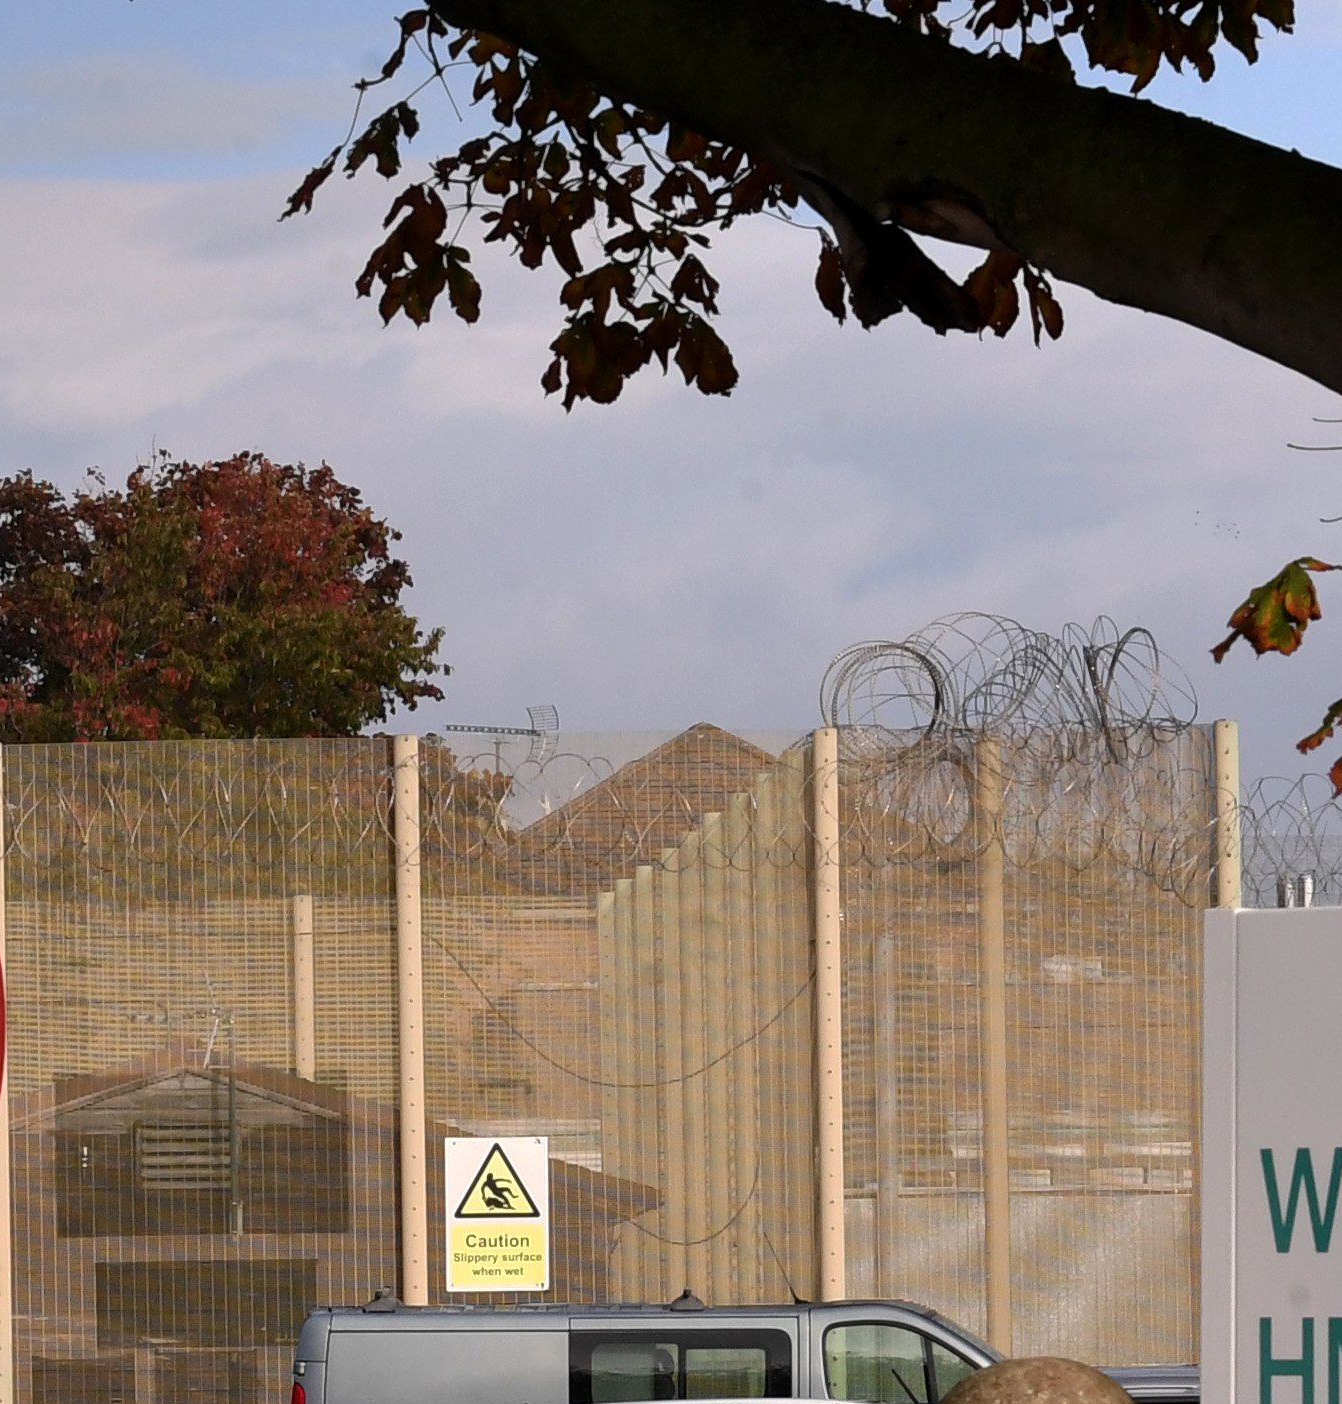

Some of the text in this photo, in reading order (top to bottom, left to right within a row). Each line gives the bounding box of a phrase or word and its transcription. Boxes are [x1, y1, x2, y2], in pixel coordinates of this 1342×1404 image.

[465, 1233, 530, 1248] Caution
[453, 1251, 543, 1265] Slippery surface
[472, 1267, 524, 1277] when wet
